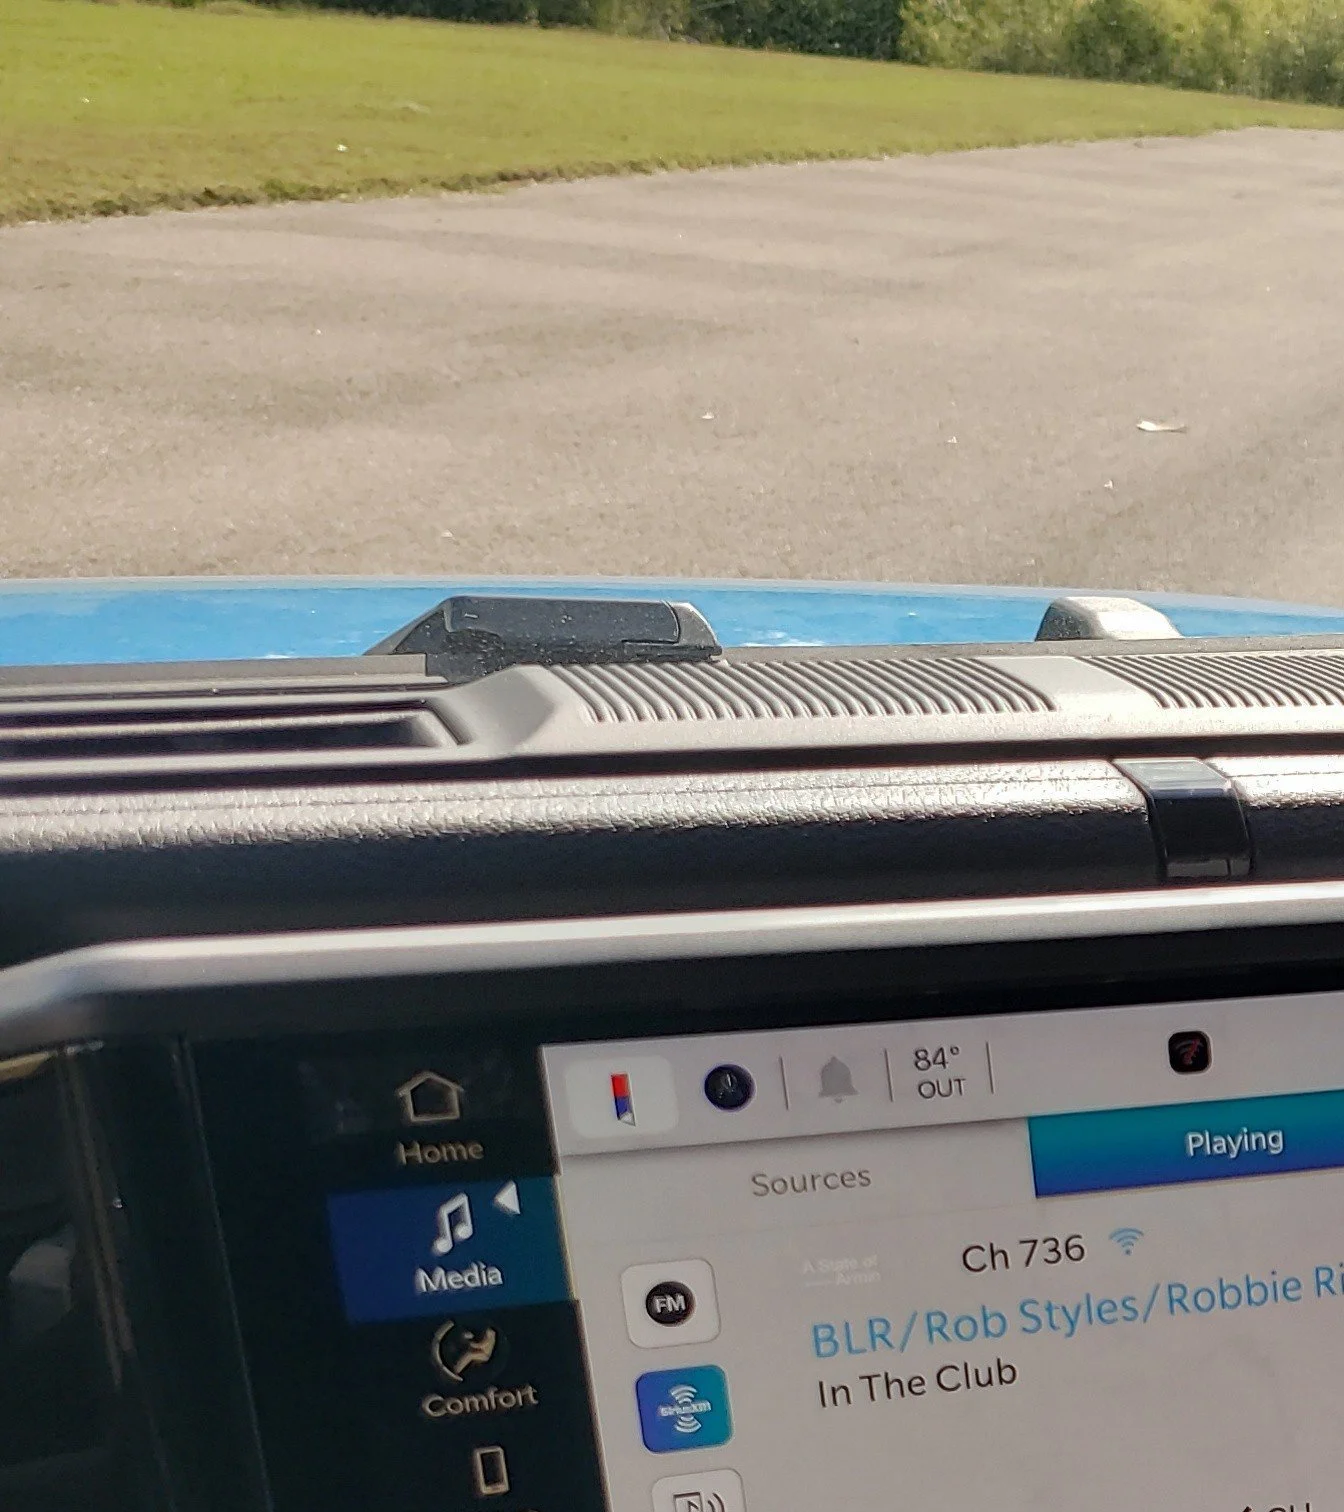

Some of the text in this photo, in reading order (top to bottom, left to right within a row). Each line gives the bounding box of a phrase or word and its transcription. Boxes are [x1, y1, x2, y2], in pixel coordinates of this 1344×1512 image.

[918, 1076, 967, 1100] OUT
[397, 1139, 484, 1166] Home
[1186, 1126, 1285, 1159] Playing
[751, 1166, 871, 1198] Sources
[961, 1234, 1086, 1275] Ch 736
[415, 1260, 504, 1294] Media
[651, 1294, 687, 1315] FM
[813, 1302, 1008, 1361] BLR/Rob
[1020, 1269, 1303, 1339] Styles/Robbie
[818, 1358, 1018, 1408] In The Club
[422, 1386, 539, 1419] Comfort
